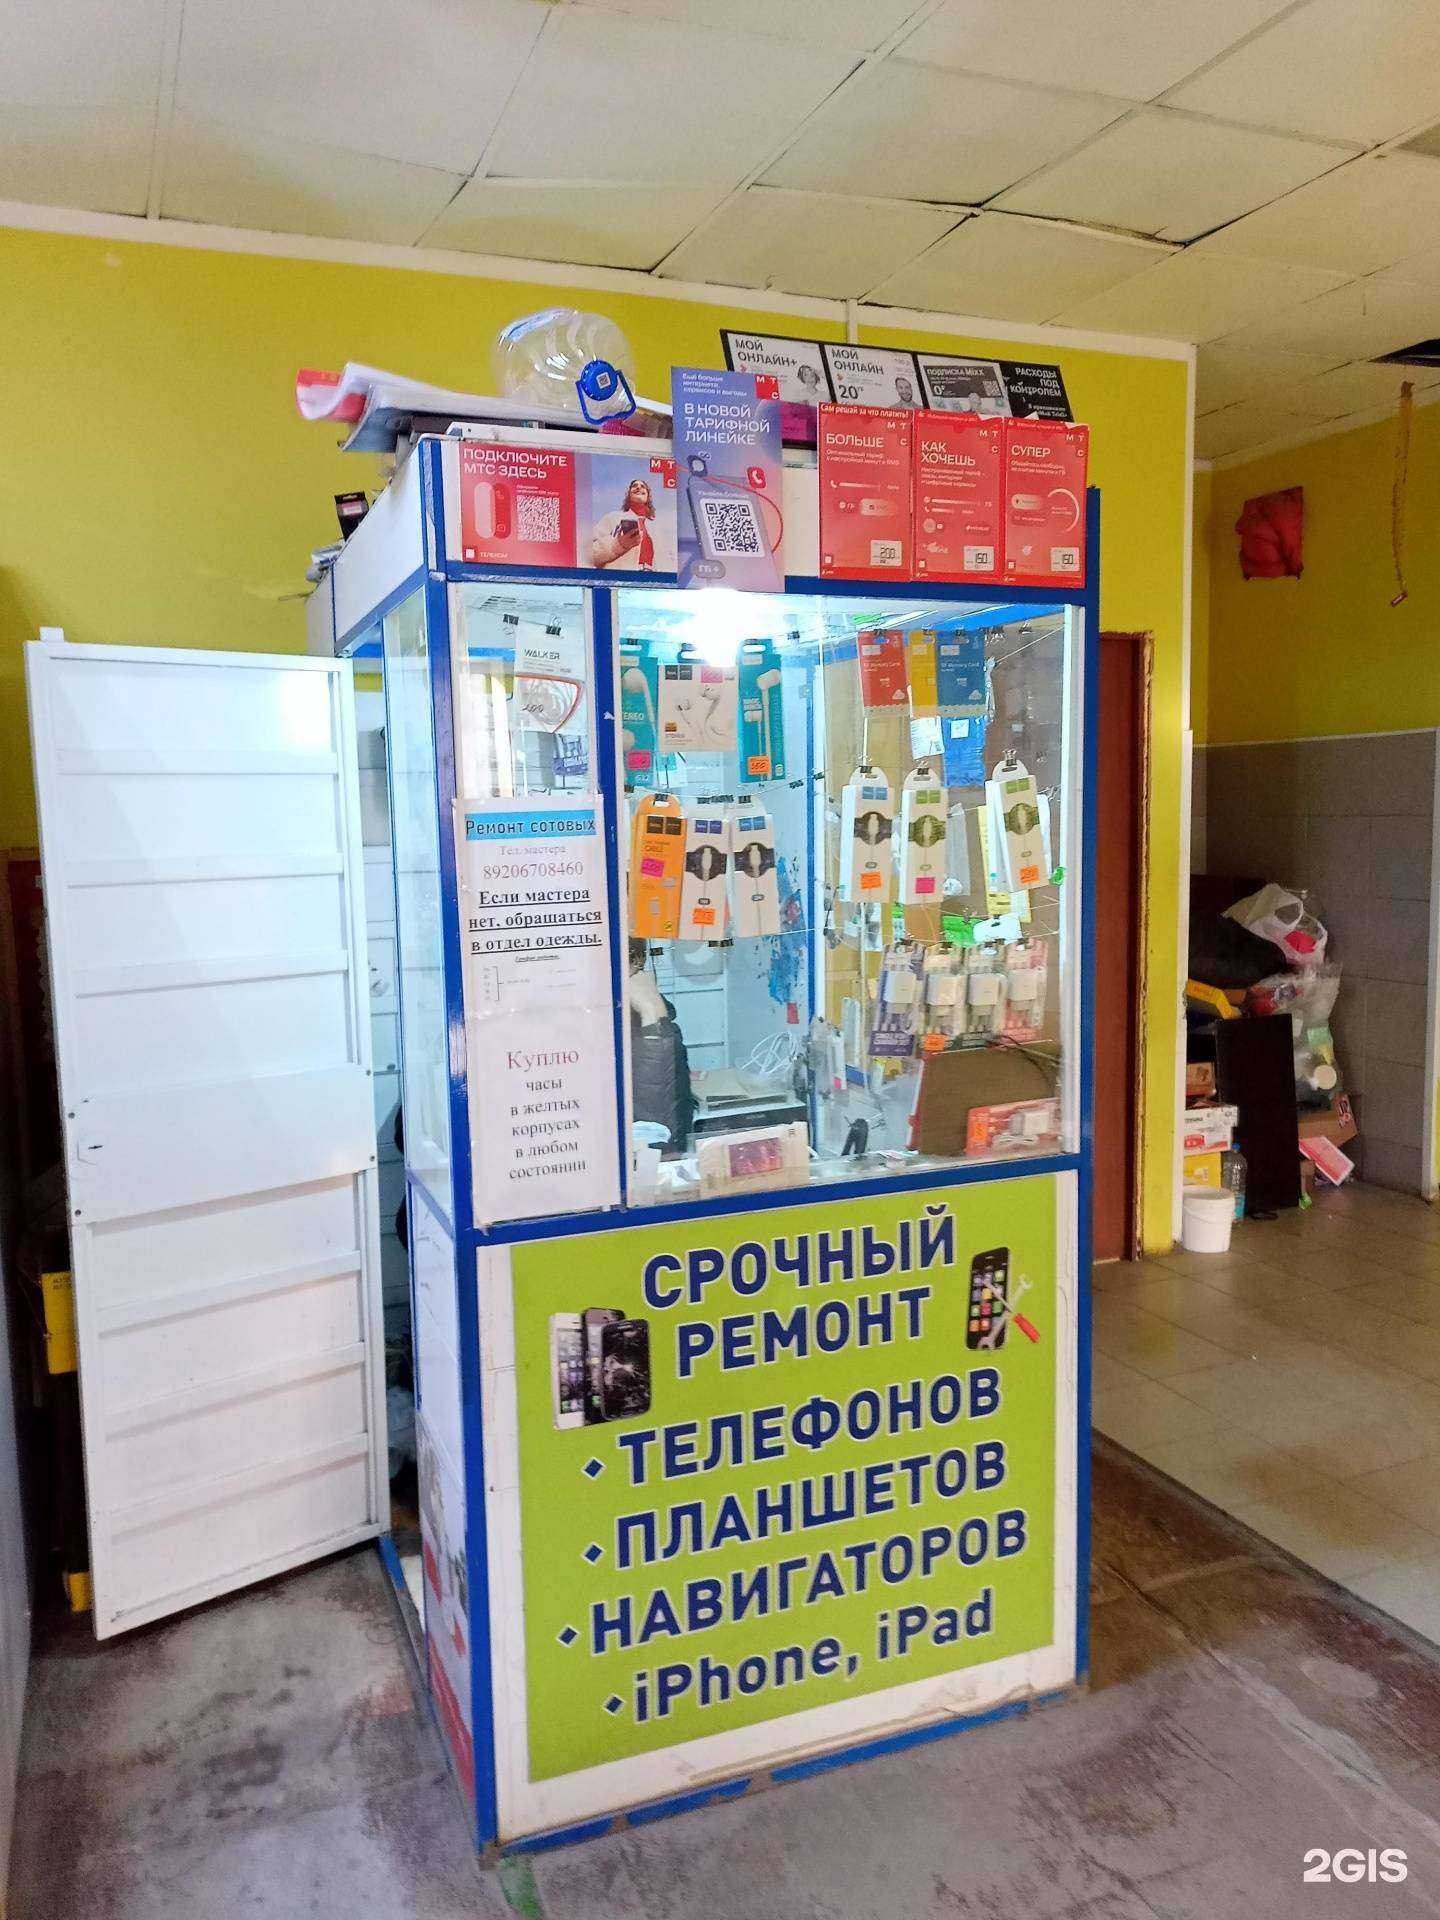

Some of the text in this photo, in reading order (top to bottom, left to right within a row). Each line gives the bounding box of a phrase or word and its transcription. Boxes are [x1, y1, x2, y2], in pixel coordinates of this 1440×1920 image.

[735, 338, 763, 351] МОЙ
[833, 360, 884, 375] ОНЛАЙН
[1015, 367, 1057, 379] РАСХОДЫ
[1009, 382, 1062, 397] КОНТРОЛЕМ
[1040, 378, 1060, 389] ПОД
[838, 384, 859, 400] 20
[685, 403, 751, 418] В НОВОЙ
[821, 403, 834, 412] Сам
[835, 406, 858, 415] решай
[880, 410, 909, 419] платить!
[685, 417, 770, 433] ТАРИФНОЙ
[685, 430, 756, 445] ЛИНЕЙКЕ
[826, 433, 884, 448] БОЛЬШЕ
[921, 441, 946, 452] КАК
[1011, 444, 1051, 457] СУПЕР
[463, 448, 568, 467] ПОДКЛЮЧИТЕ
[921, 452, 976, 466] ХОЧЕШЬ
[463, 462, 548, 479] МТС ЗДЕСЬ
[524, 649, 560, 660] WALKER
[623, 712, 644, 720] EREO
[466, 818, 596, 835] Ремонт сотовых
[524, 845, 566, 856] мастера
[483, 861, 584, 879] 89206708460
[479, 888, 590, 905] Если мастера
[472, 931, 602, 951] в отдел одежды.
[507, 1050, 579, 1072] Куплю
[526, 1078, 563, 1092] часы
[511, 1099, 580, 1116] в желтых
[512, 1119, 580, 1137] корпусах
[515, 1141, 579, 1158] в любом
[509, 1160, 587, 1179] состоянии
[643, 1202, 956, 1309] СРОЧНЫЙ
[677, 1287, 931, 1377] РЕМОНТ
[617, 1368, 1001, 1485] ТЕЛЕФОНОВ
[616, 1440, 1007, 1569] ПЛАНШЕТОВ
[591, 1508, 1028, 1655] НАВИГАТОРОВ
[634, 1588, 993, 1724] iPhone, iPad
